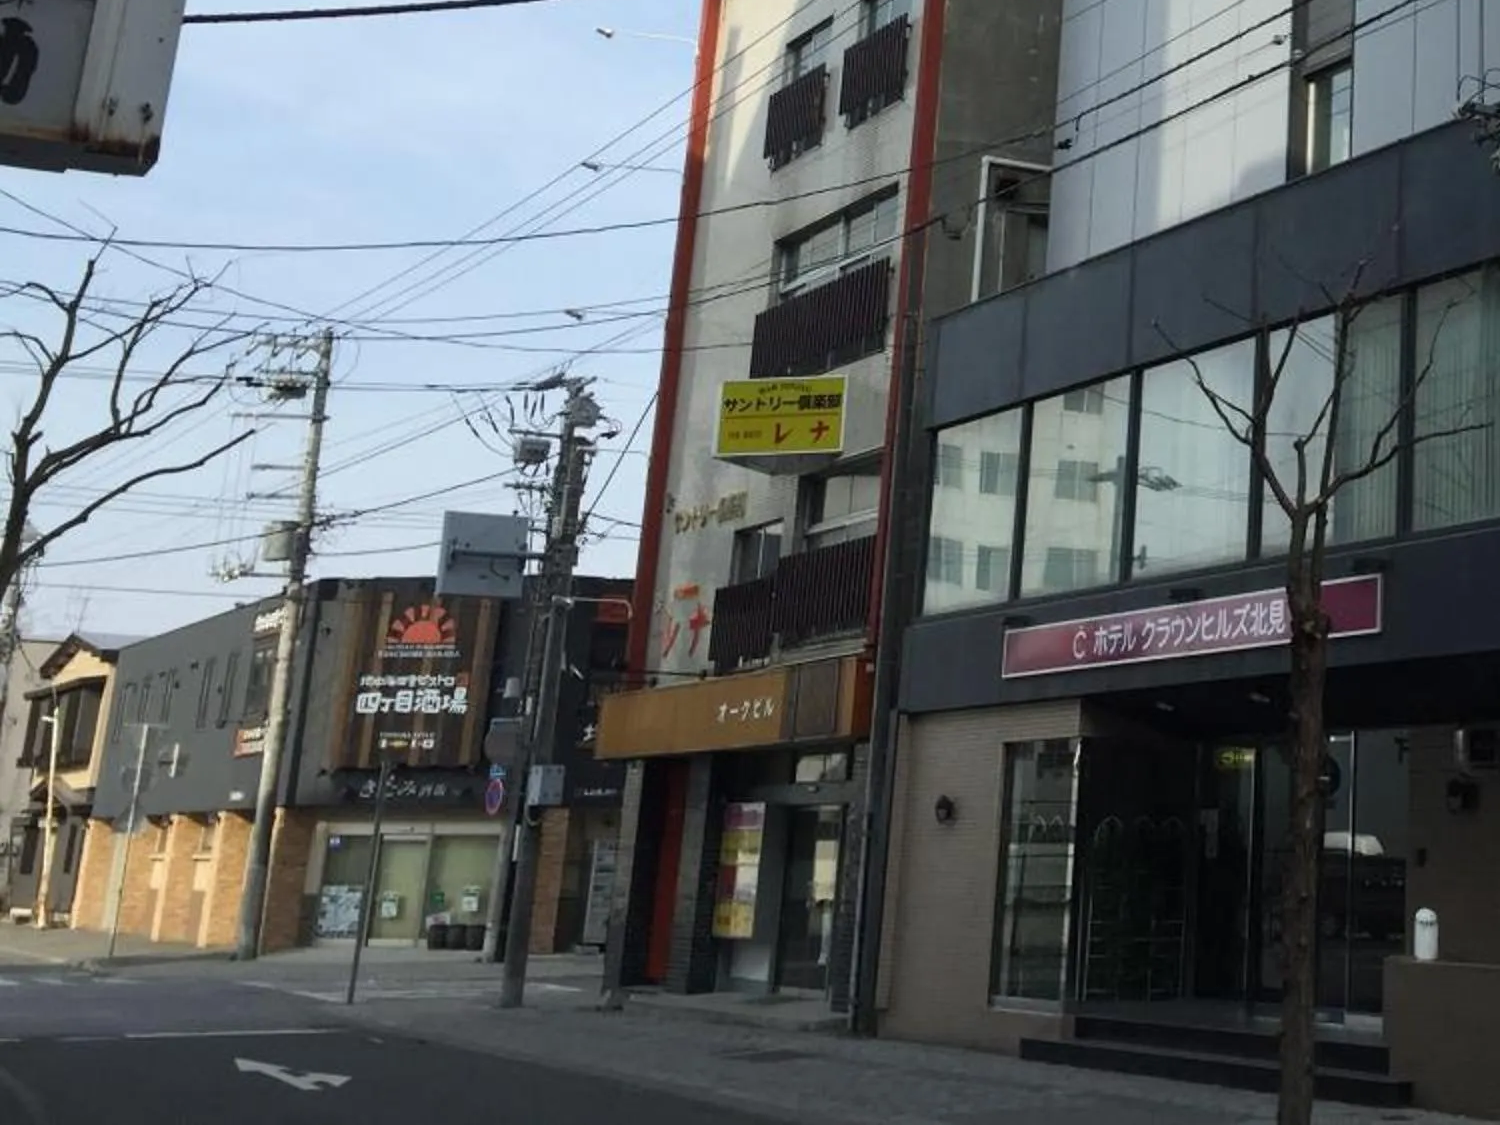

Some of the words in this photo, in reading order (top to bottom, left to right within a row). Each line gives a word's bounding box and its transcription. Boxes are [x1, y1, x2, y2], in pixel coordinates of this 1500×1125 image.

[1093, 622, 1137, 657] ホテル
[1141, 598, 1286, 651] クラウンヒルズ北見
[356, 686, 469, 715] 四丁目酒場
